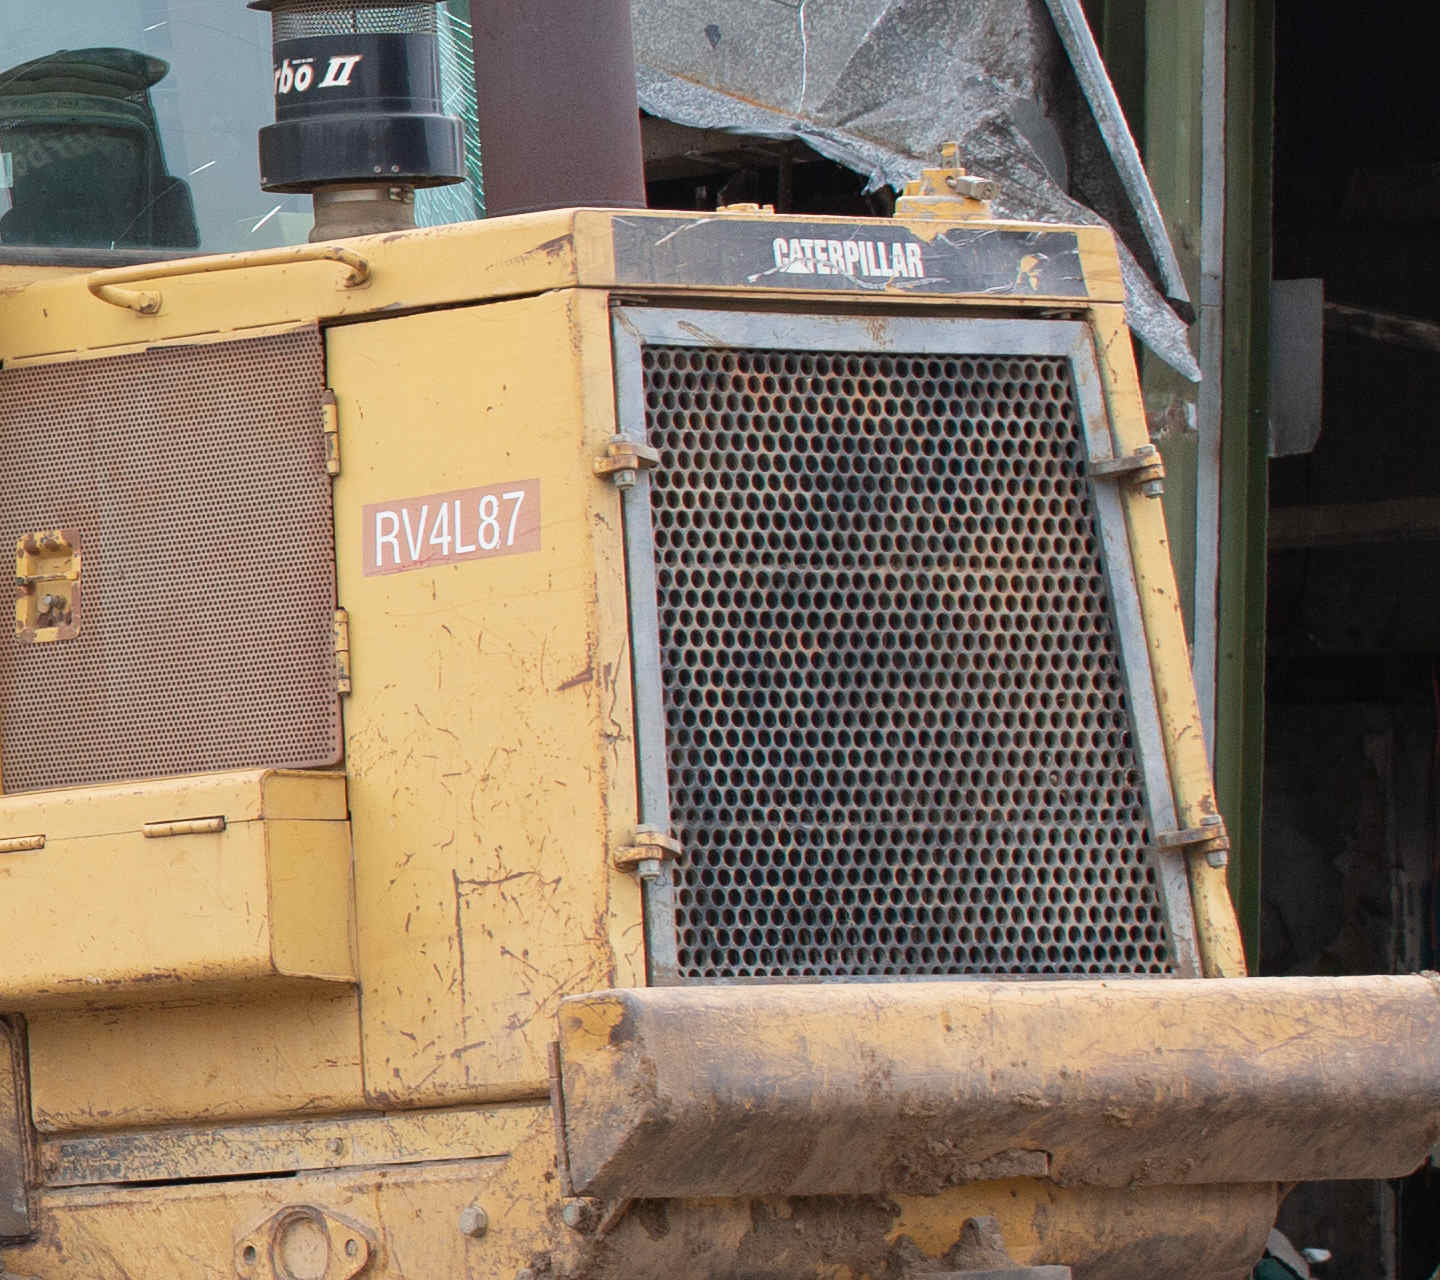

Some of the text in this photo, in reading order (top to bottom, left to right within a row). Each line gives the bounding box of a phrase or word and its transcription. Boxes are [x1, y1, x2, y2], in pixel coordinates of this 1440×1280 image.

[318, 54, 364, 88] II
[773, 238, 926, 278] CATERPILLAR
[375, 491, 525, 566] RV4L87
